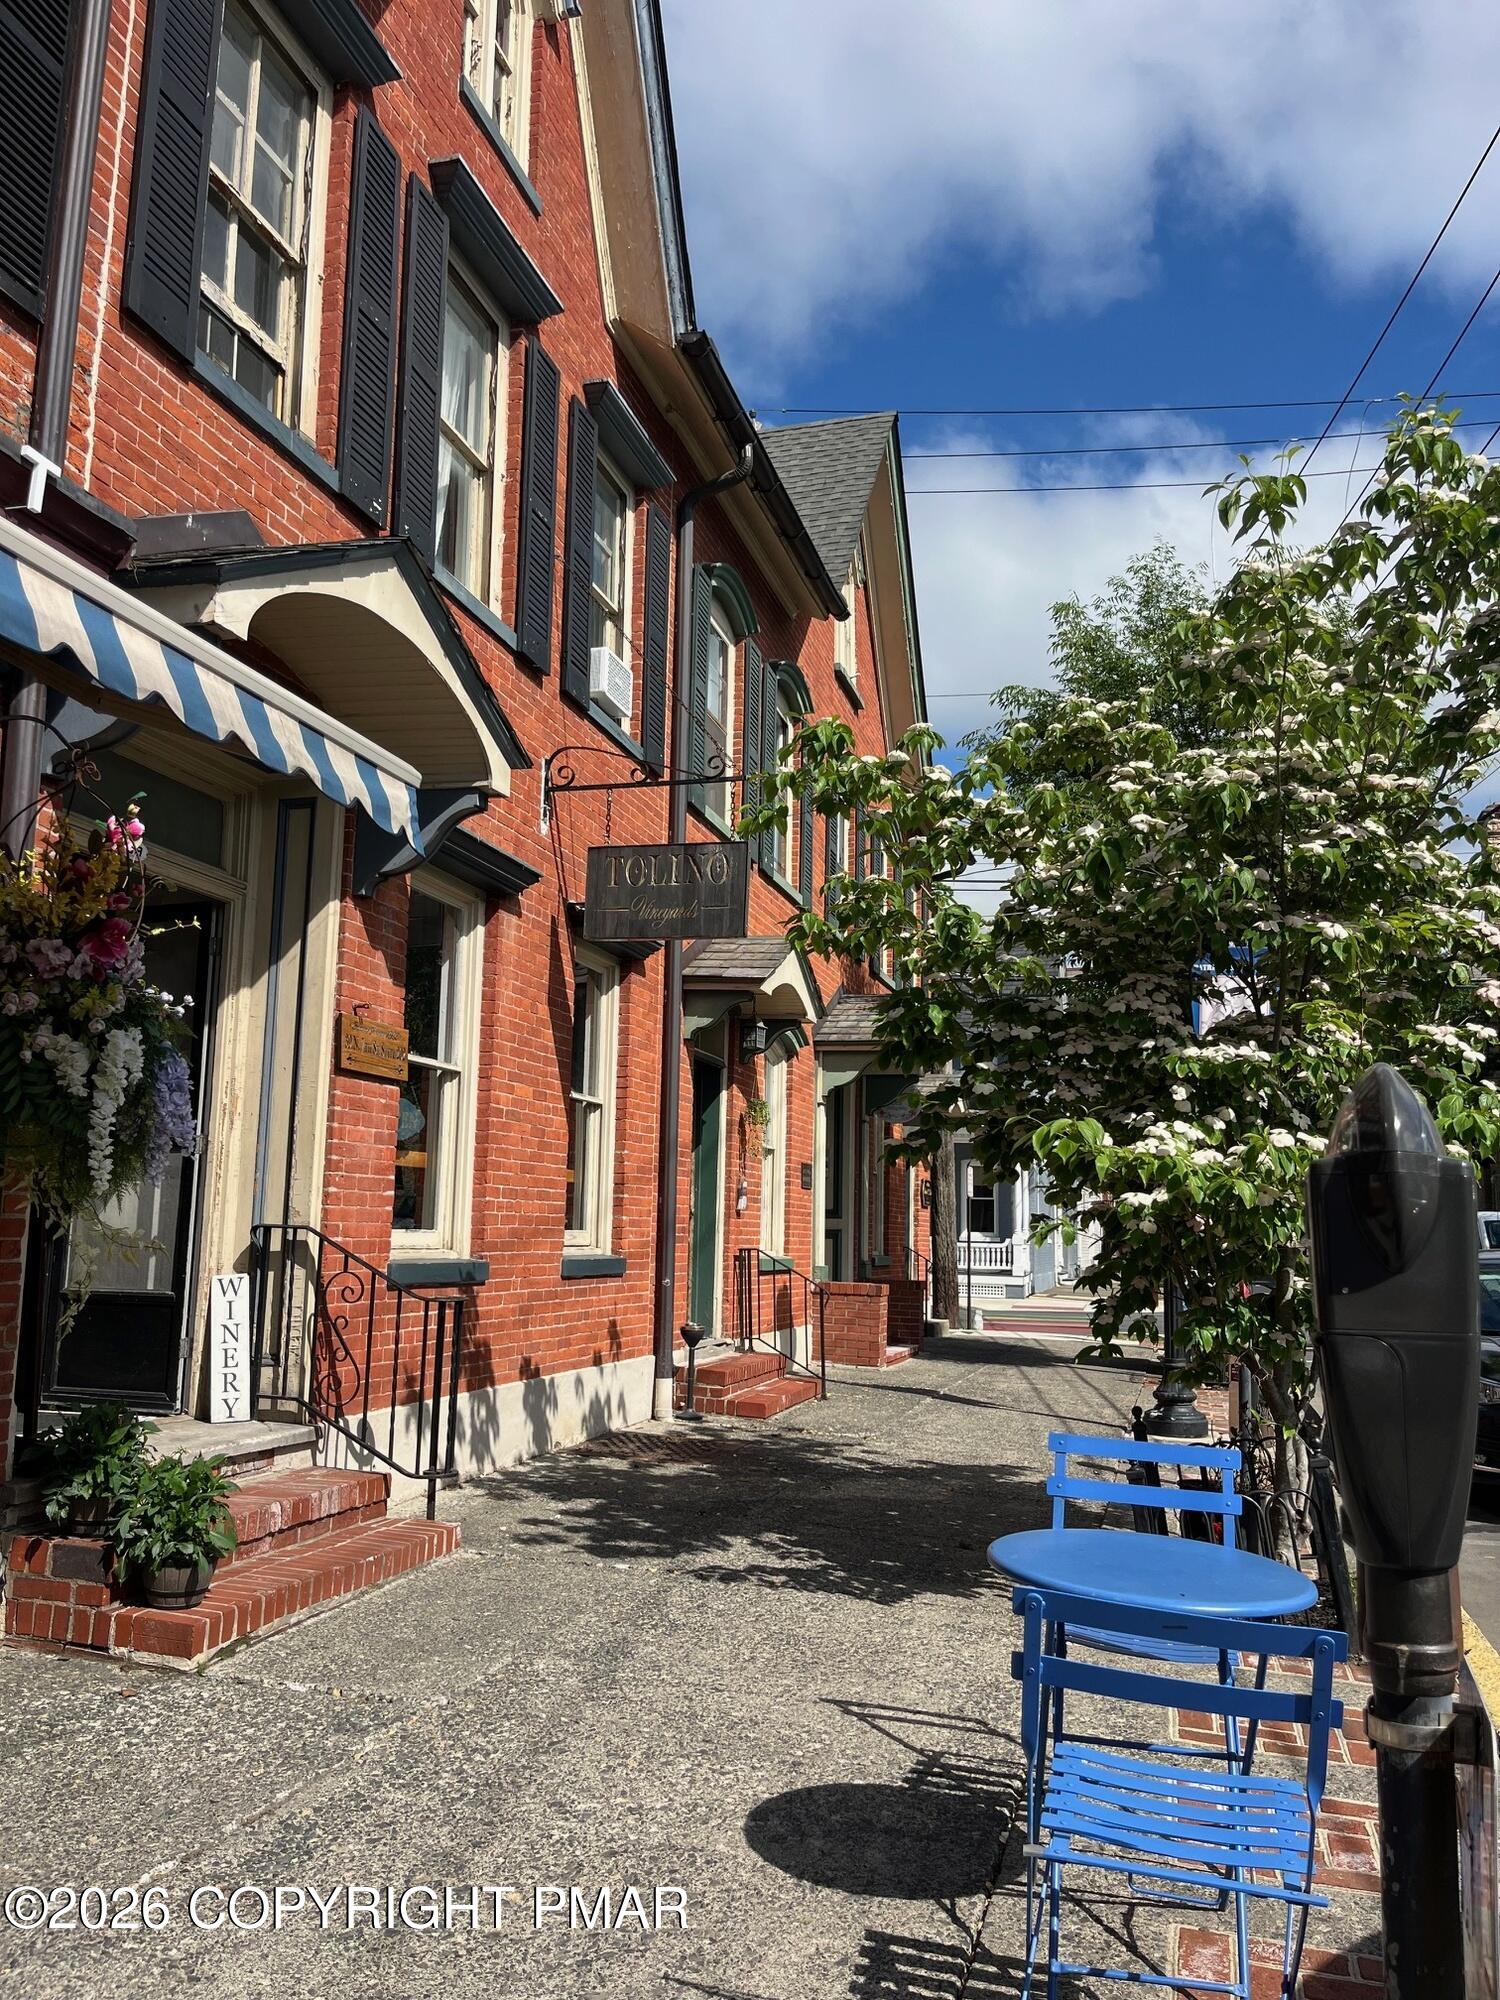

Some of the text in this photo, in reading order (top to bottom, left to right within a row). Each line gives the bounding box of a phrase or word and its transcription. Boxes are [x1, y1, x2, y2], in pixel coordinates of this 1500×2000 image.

[605, 851, 730, 888] TOLINO
[631, 894, 698, 929] Vineyards
[217, 1277, 244, 1419] WINERY
